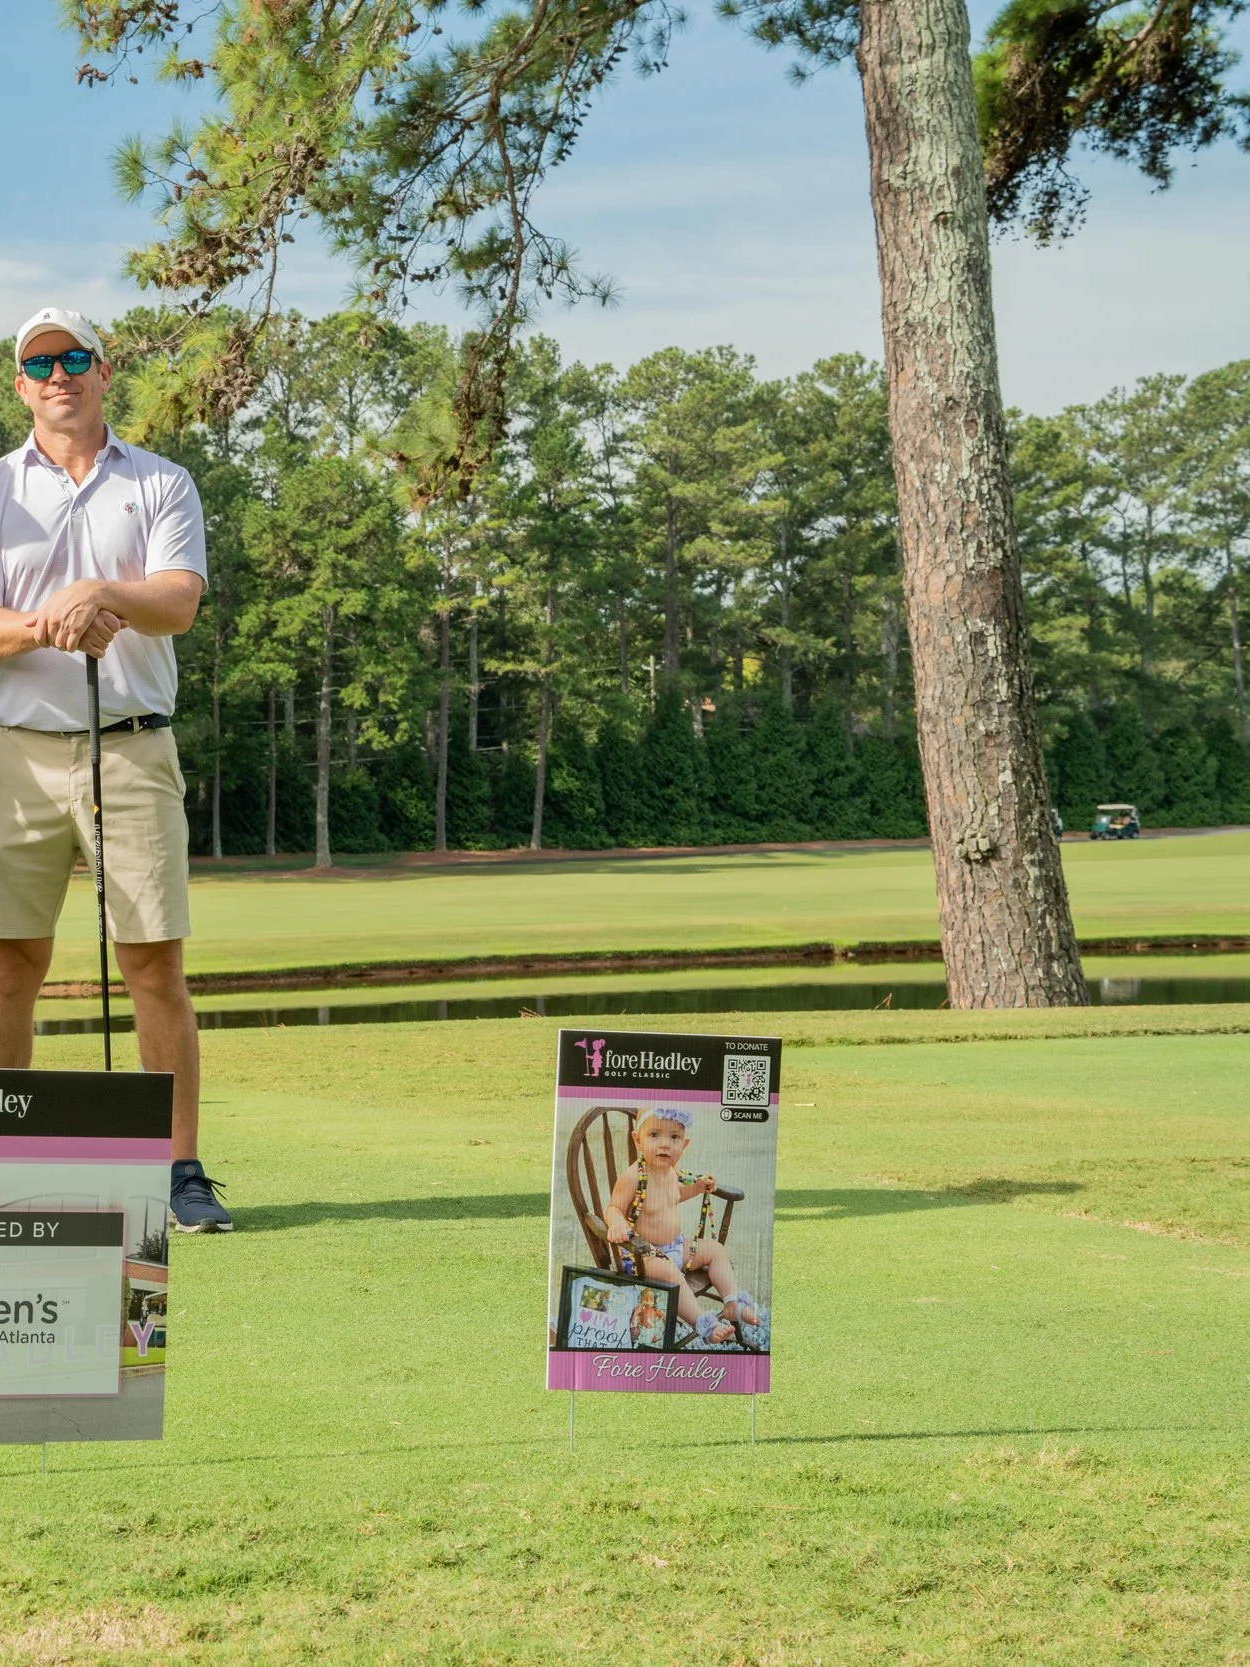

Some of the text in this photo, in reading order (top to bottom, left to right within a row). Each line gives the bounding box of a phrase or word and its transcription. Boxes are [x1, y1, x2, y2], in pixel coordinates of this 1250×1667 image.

[724, 1041, 768, 1051] TO DONATE
[733, 1111, 763, 1120] SCAN ME
[32, 1222, 60, 1238] BY
[568, 1322, 630, 1349] proof
[592, 1354, 728, 1391] Fore Hailey
